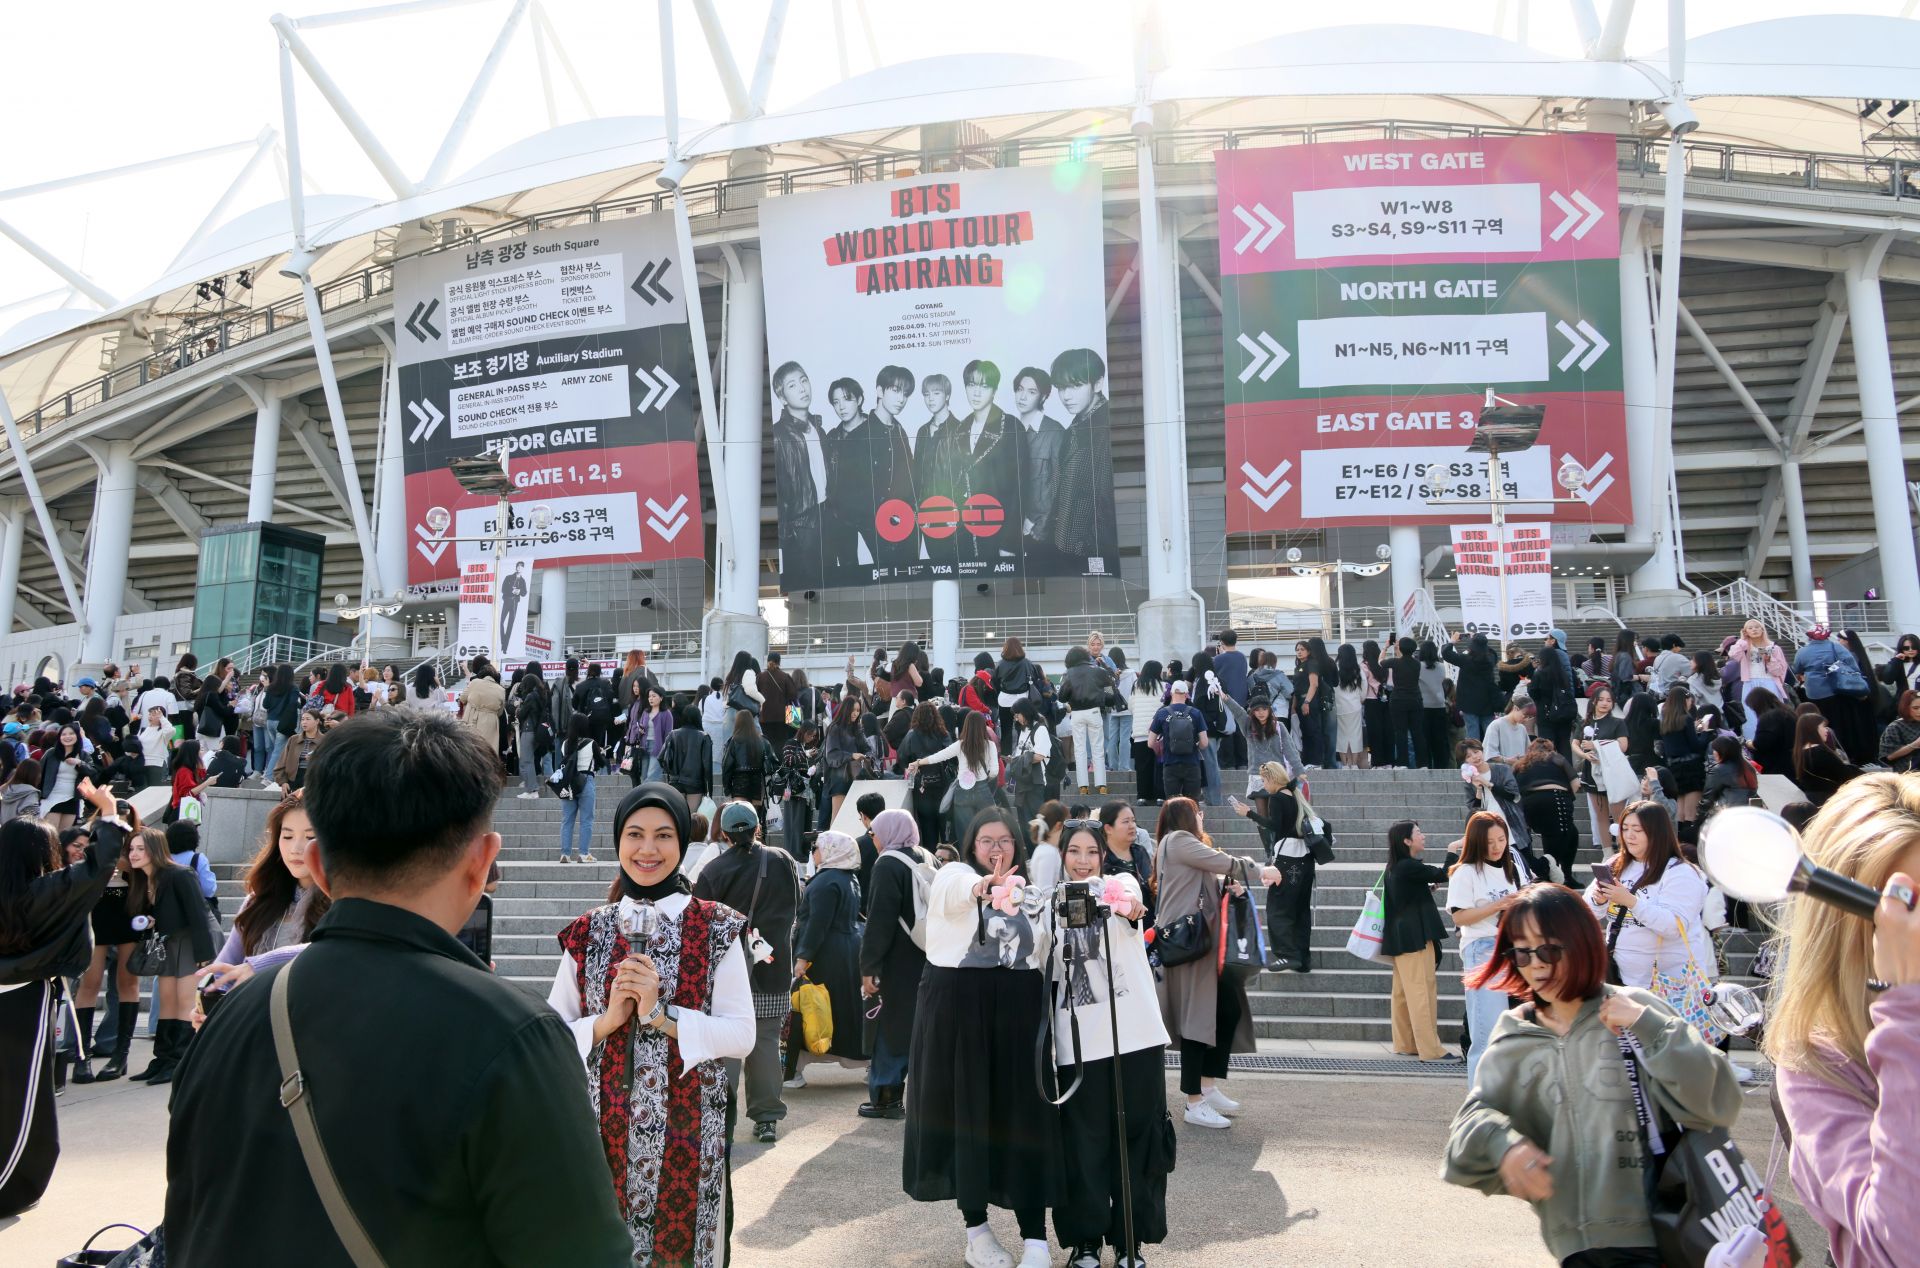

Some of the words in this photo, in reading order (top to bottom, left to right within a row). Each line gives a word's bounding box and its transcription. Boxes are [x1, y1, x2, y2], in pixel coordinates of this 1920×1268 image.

[1343, 152, 1413, 172] WEST
[1420, 151, 1485, 170] GATE
[899, 183, 951, 219] BTS
[1380, 200, 1453, 215] W1~W8
[1331, 222, 1397, 240] S3~S4,
[1400, 220, 1467, 235] S9~S11
[1471, 217, 1503, 236] 구역
[835, 220, 933, 263] WORLD
[945, 213, 1021, 249] TOUR
[466, 249, 494, 270] 남측
[498, 241, 527, 263] 광장
[533, 242, 561, 255] South
[564, 238, 600, 251] Square
[560, 263, 583, 275] 협찬사
[585, 261, 601, 272] 부스
[866, 253, 993, 296] ARIRANG
[449, 284, 463, 296] 공식
[465, 280, 486, 292] 응원봉
[488, 273, 525, 288] 익스프레스
[527, 269, 542, 280] 부스
[560, 273, 589, 283] SPONSOR
[590, 270, 611, 279] BOOTH
[449, 293, 473, 303] OFFICIAL
[474, 291, 490, 299] LIGHT
[491, 288, 507, 296] STICK
[507, 283, 534, 294] EXPRESS
[535, 278, 554, 287] BOOTH
[561, 284, 593, 297] 티켓박스
[1340, 280, 1427, 301] NORTH
[1433, 279, 1498, 299] GATE
[450, 306, 465, 317] 공식
[466, 303, 480, 314] 앨범
[499, 297, 513, 308] 수령
[515, 293, 530, 304] 부스
[562, 296, 582, 304] TICKET
[914, 302, 944, 310] GOYANG
[451, 315, 475, 324] OFFICIAL
[476, 311, 495, 319] ALBUM
[496, 306, 516, 316] PICKUP
[517, 303, 537, 312] BOOTH
[451, 327, 466, 338] 앨범
[467, 324, 482, 335] 예약
[483, 319, 505, 332] 구매자
[506, 314, 537, 327] SOUND
[540, 309, 570, 320] CHECK
[571, 306, 595, 318] 이벤트
[597, 304, 613, 314] 부스
[901, 312, 928, 320] GOYANG
[929, 310, 956, 319] STADIUM
[452, 336, 471, 345] ALBUM
[504, 327, 524, 336] SOUND
[524, 322, 545, 332] CHECK
[545, 320, 564, 328] EVENT
[565, 318, 586, 326] BOOTH
[888, 322, 927, 332] 2026.04.09.
[889, 332, 928, 341] 2026.04.11.
[1334, 342, 1398, 360] N1~N5,
[1402, 341, 1471, 356] N6~N11
[1475, 338, 1509, 357] 구역
[453, 360, 483, 380] 보조
[486, 350, 530, 376] 경기장
[536, 352, 579, 366] Auxiliary
[581, 347, 623, 360] Stadium
[561, 375, 586, 386] ARMY
[589, 373, 613, 383] ZONE
[457, 389, 495, 402] GENERAL
[496, 383, 530, 396] IN-PASS
[531, 380, 547, 391] 부스
[457, 402, 483, 410] GENERAL
[504, 394, 524, 403] BOOTH
[457, 410, 487, 423] SOUND
[527, 402, 542, 413] 전용
[544, 400, 558, 410] 부스
[458, 422, 478, 431] SOUND
[479, 420, 498, 428] CHECK
[498, 417, 517, 425] BOOTH
[1316, 412, 1379, 433] EAST
[1385, 411, 1452, 431] GATE
[550, 426, 597, 447] GATE
[514, 467, 563, 488] GATE
[568, 466, 584, 485] 1,
[588, 464, 607, 482] 2,
[611, 462, 622, 479] 5
[1342, 463, 1398, 479] E1~E6
[1335, 483, 1402, 500] E7~E12
[583, 508, 607, 523] 구역
[590, 525, 614, 541] 구역
[1465, 530, 1484, 540] BTS
[1517, 528, 1537, 539] BTS
[1459, 542, 1493, 553] WORLD
[1510, 539, 1546, 551] WORLD
[1464, 553, 1489, 564] TOUR
[1514, 552, 1542, 563] TOUR
[470, 564, 485, 573] BTS
[930, 565, 952, 574] VISA
[1456, 564, 1499, 577] ARIRANG
[464, 573, 489, 583] WORLD
[407, 583, 431, 595] EAST
[466, 585, 485, 593] TOUR
